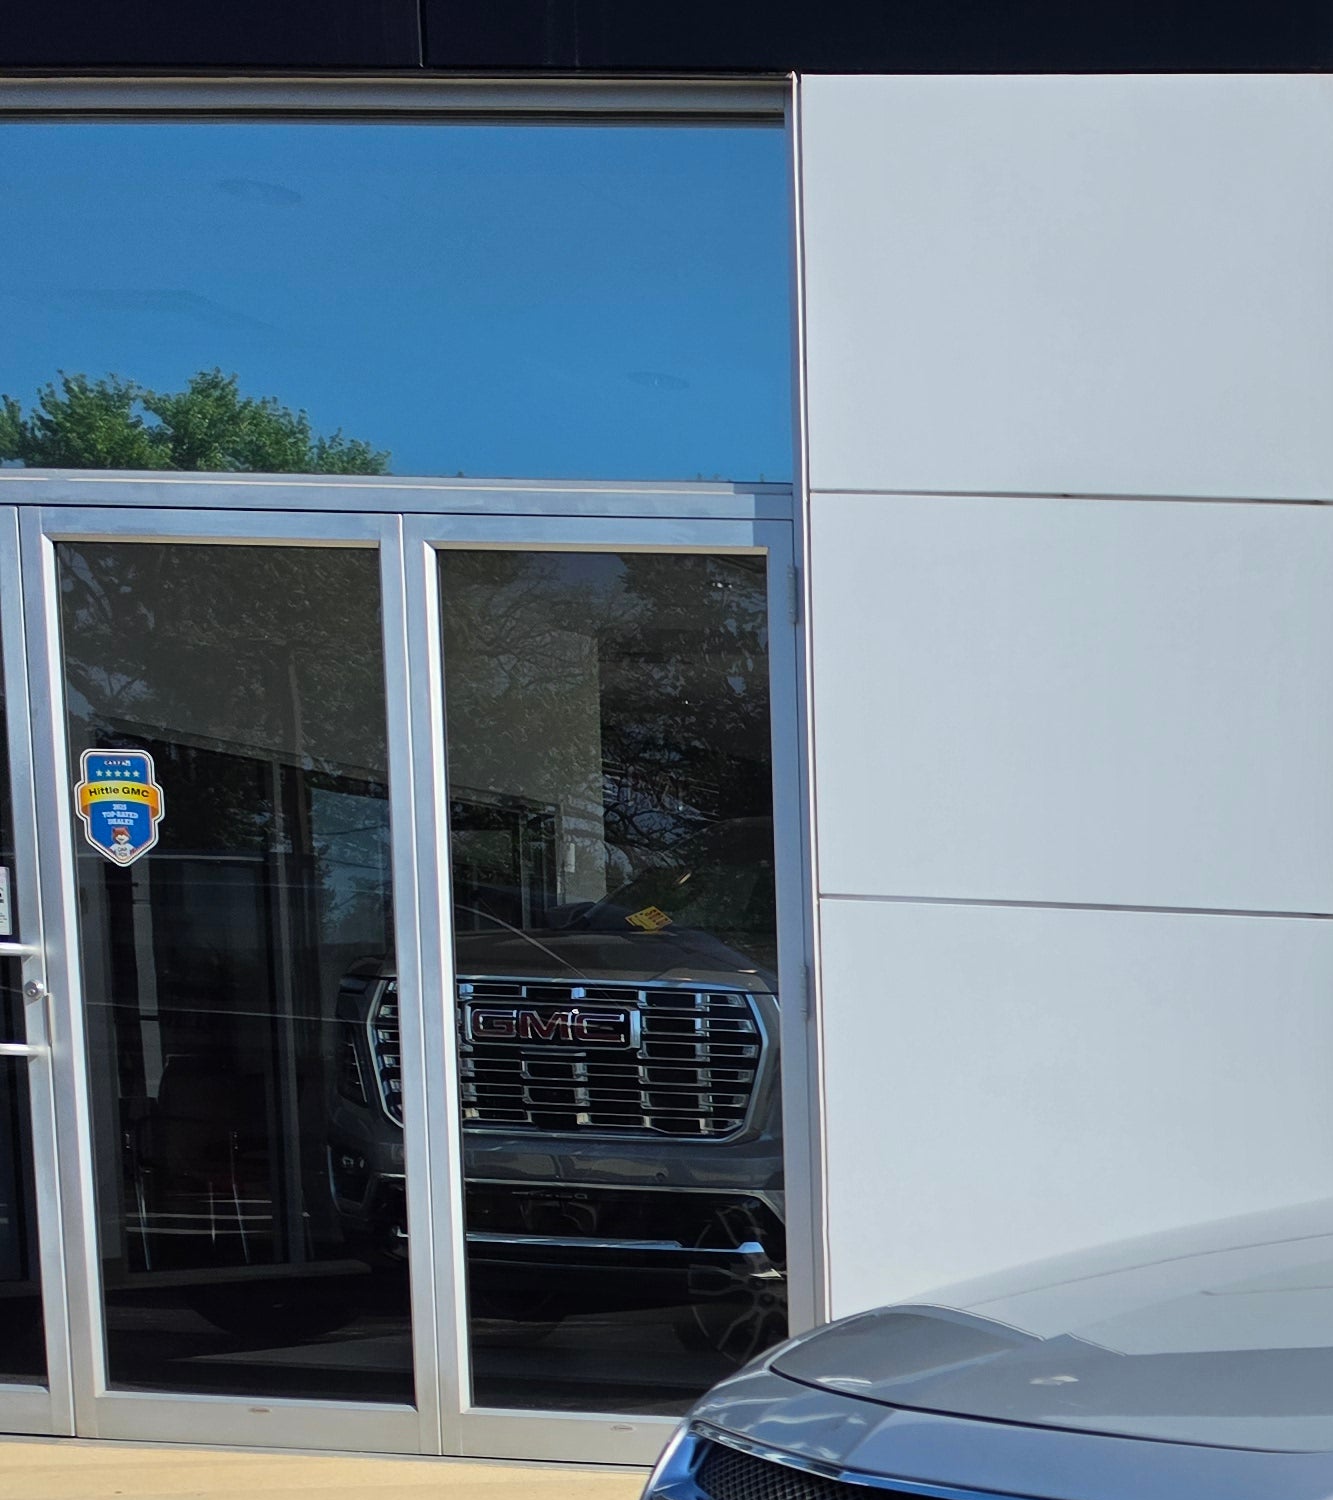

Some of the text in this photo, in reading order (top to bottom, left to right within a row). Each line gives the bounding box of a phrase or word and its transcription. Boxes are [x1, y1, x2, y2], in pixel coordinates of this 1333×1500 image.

[89, 786, 150, 798] Hittle GMC
[471, 1008, 626, 1043] GMC
